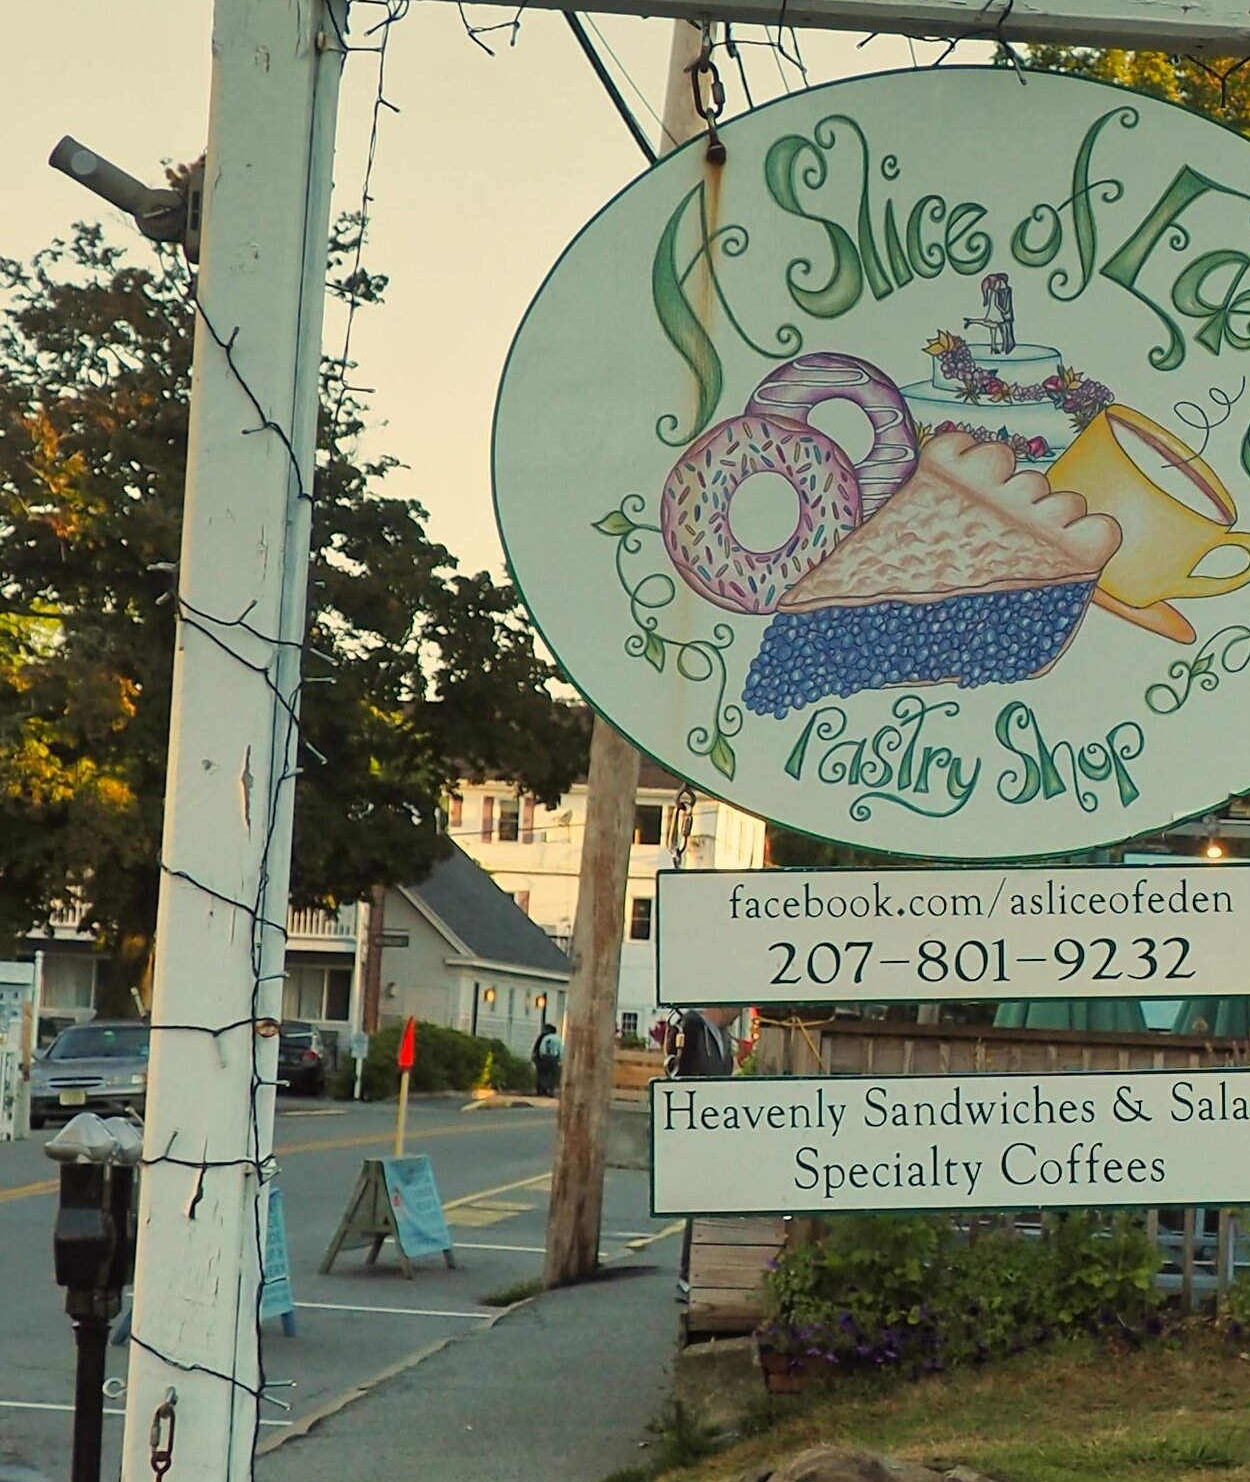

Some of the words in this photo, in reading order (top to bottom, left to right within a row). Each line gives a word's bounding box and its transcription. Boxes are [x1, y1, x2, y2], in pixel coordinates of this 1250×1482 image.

[652, 179, 803, 448] A
[764, 114, 993, 319] Slice
[1010, 105, 1140, 302] of
[784, 694, 982, 822] Pastry
[995, 700, 1144, 813] Shop
[729, 877, 1234, 918] facebook.com/asliceofeden
[768, 936, 1197, 985] 207-801-9232
[662, 1087, 847, 1137] Heavenly
[863, 1085, 1096, 1128] Sandwiches
[1112, 1084, 1153, 1123] &
[794, 1144, 983, 1199] Specialty
[1000, 1141, 1166, 1186] Coffees
